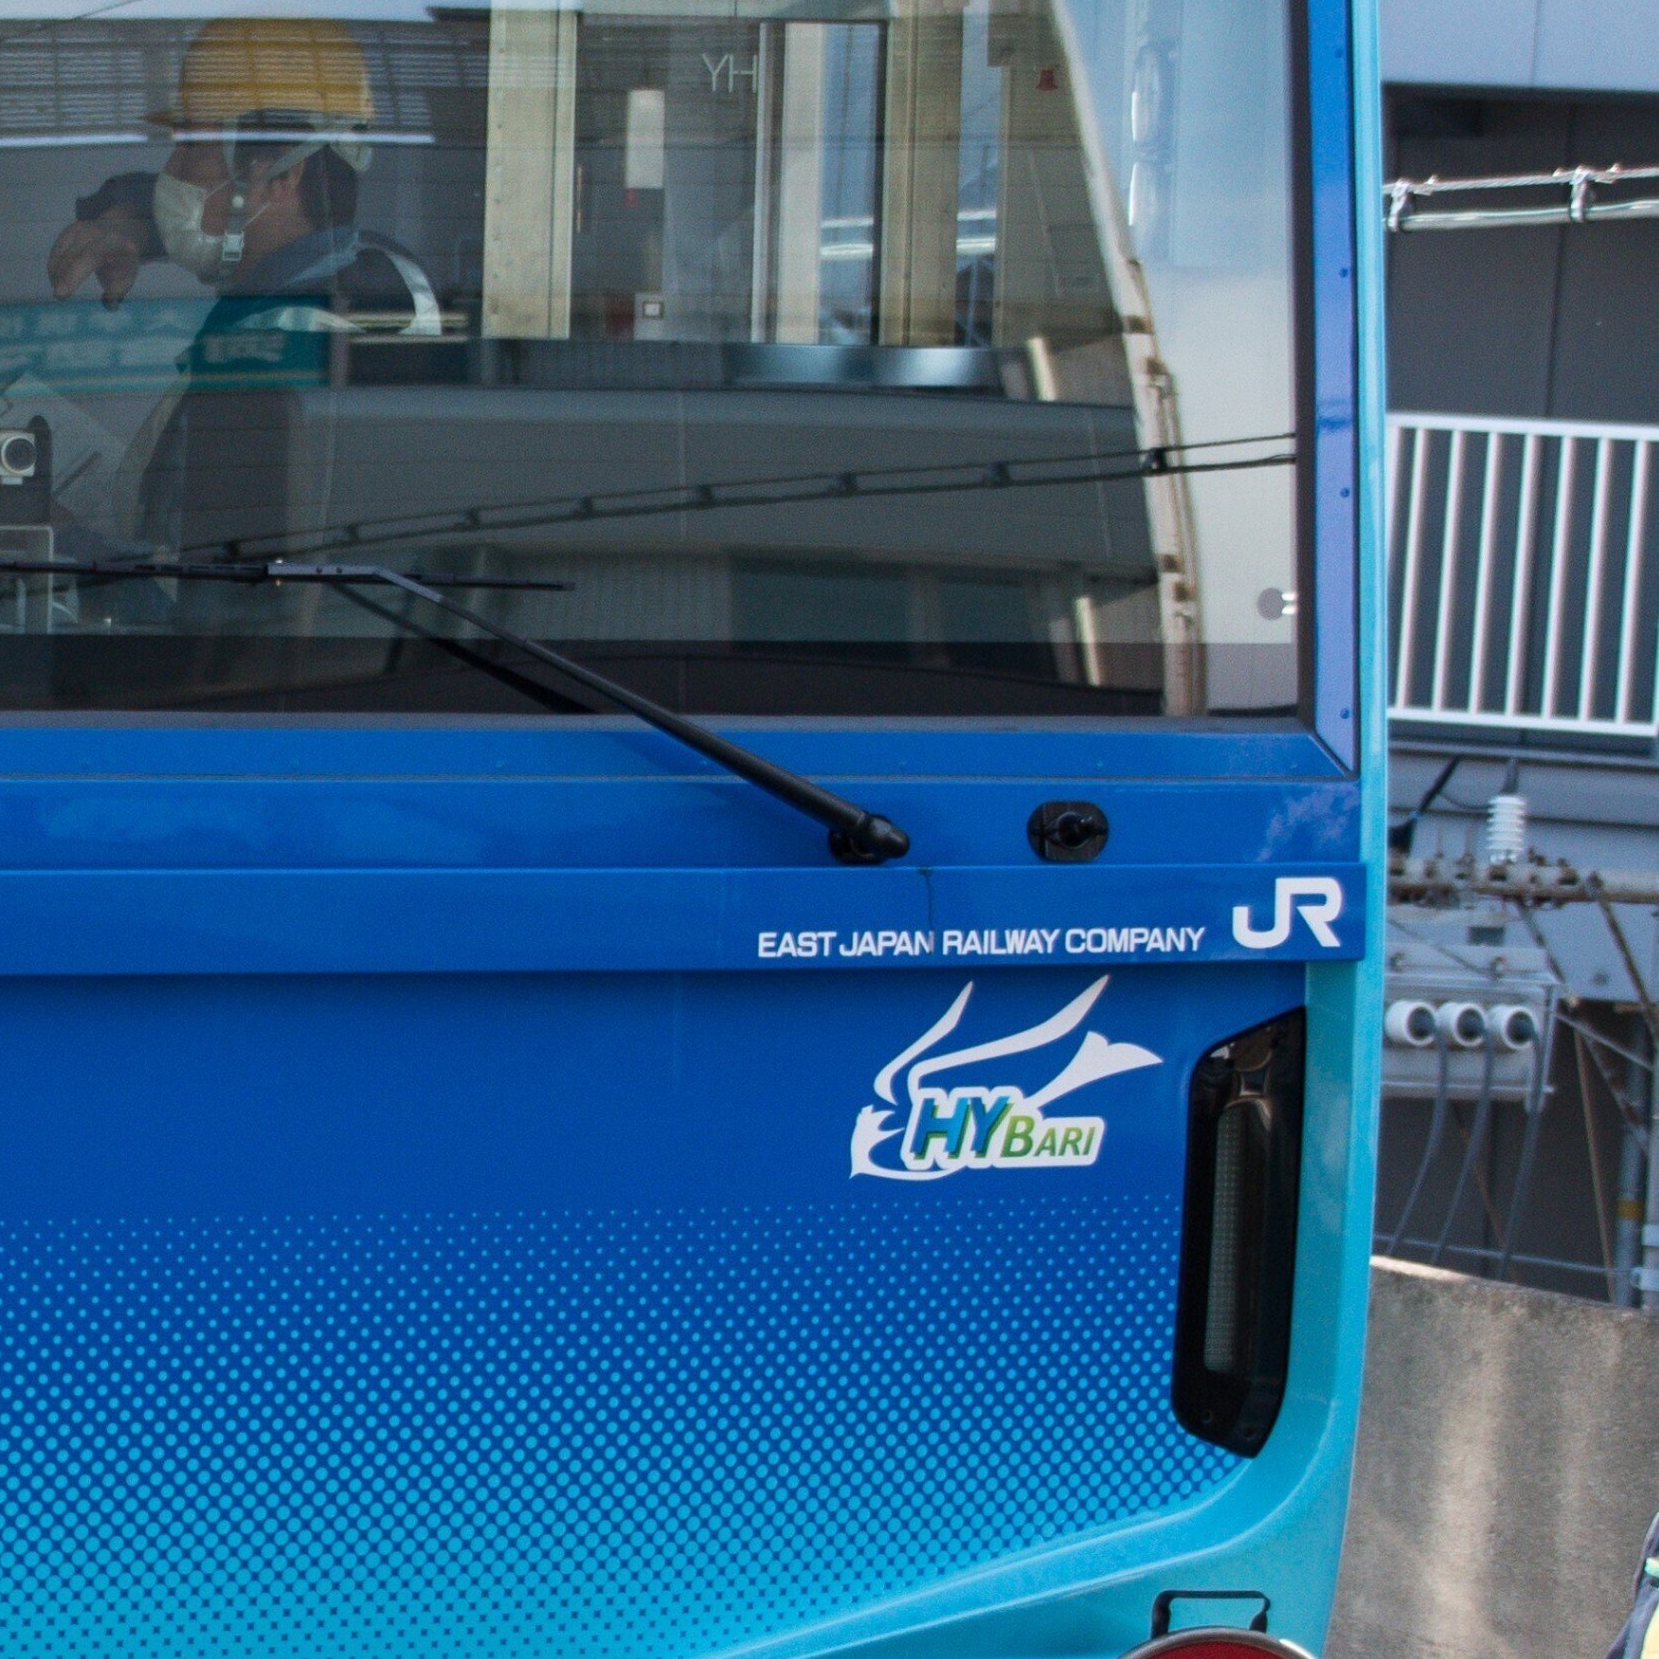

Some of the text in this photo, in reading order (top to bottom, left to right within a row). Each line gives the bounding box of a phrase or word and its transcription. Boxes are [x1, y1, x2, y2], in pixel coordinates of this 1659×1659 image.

[1232, 876, 1342, 949] JR
[757, 927, 1206, 958] EAST JAPAN RAILWAY COMPANY
